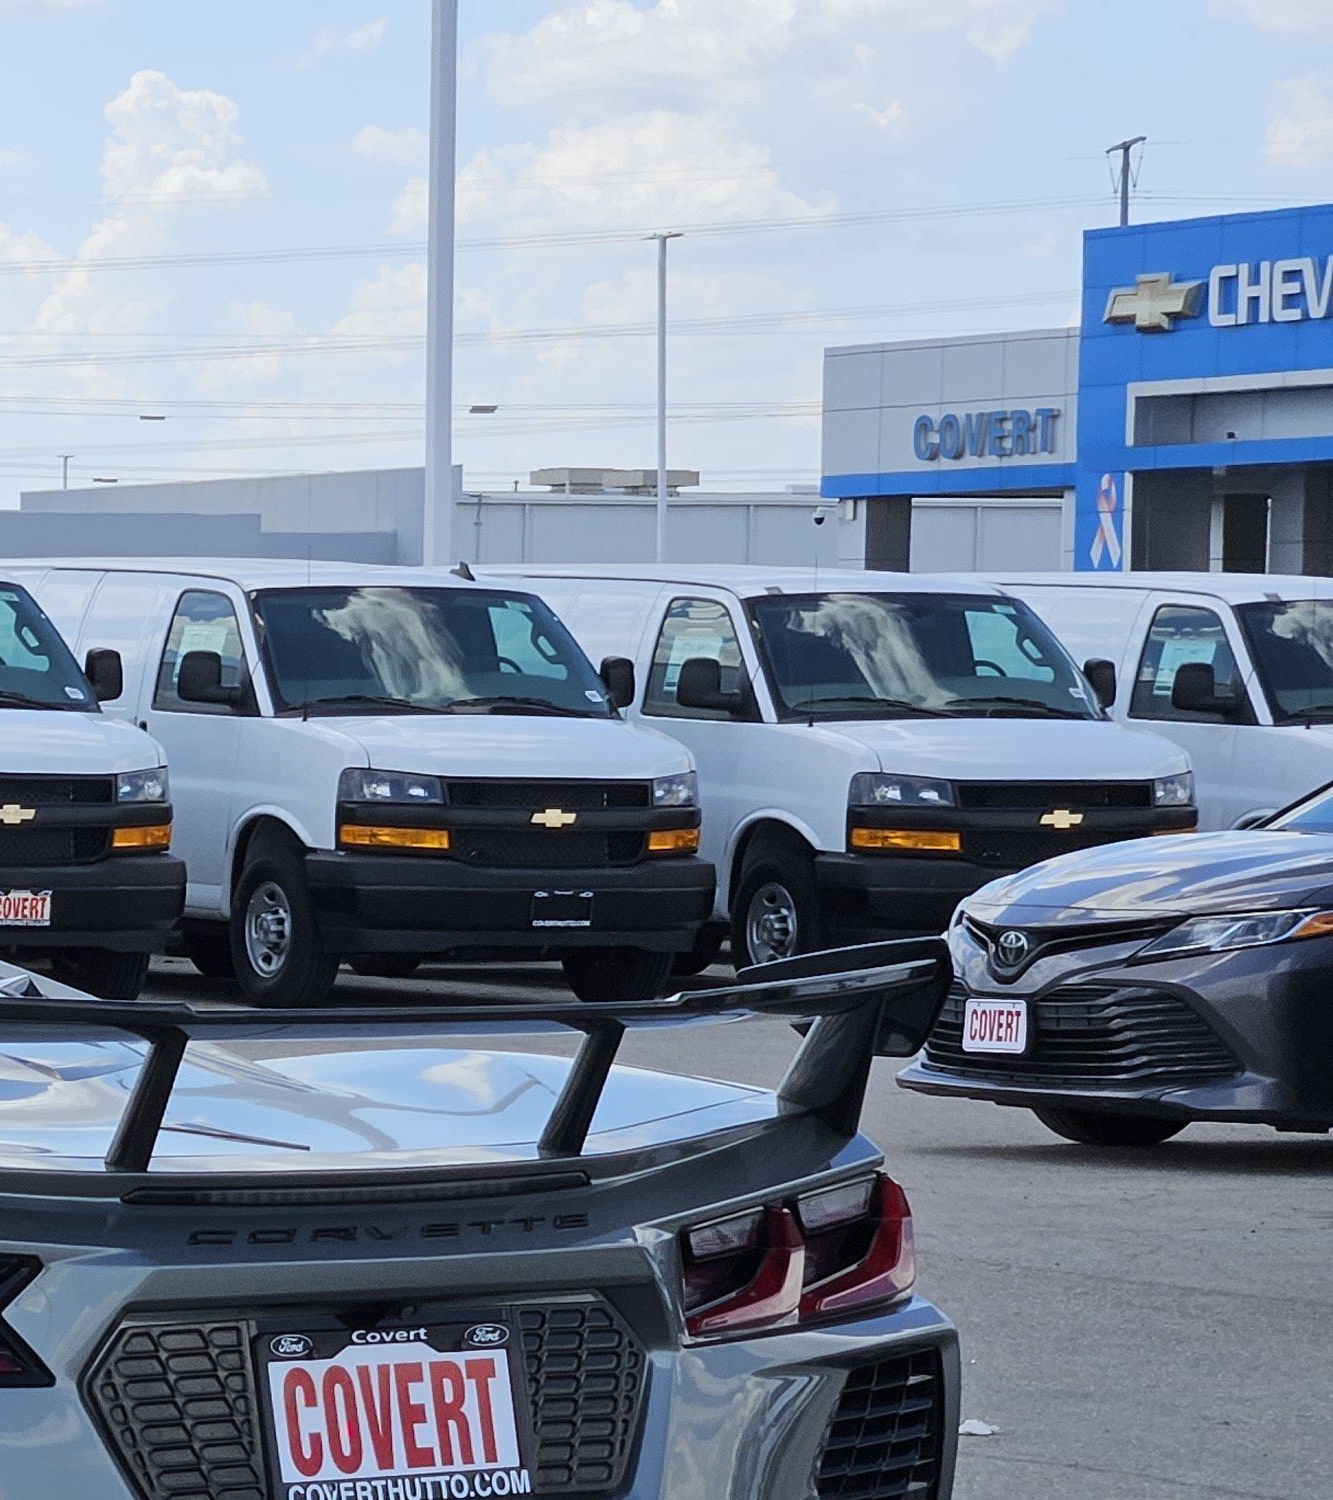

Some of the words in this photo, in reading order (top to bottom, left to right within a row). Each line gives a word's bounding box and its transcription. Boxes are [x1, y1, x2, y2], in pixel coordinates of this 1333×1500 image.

[913, 407, 1060, 461] COVERT
[969, 1008, 1022, 1043] COVERT
[186, 1212, 590, 1246] CORVETTE
[351, 1327, 429, 1344] Covert
[283, 1357, 498, 1478] COVERT
